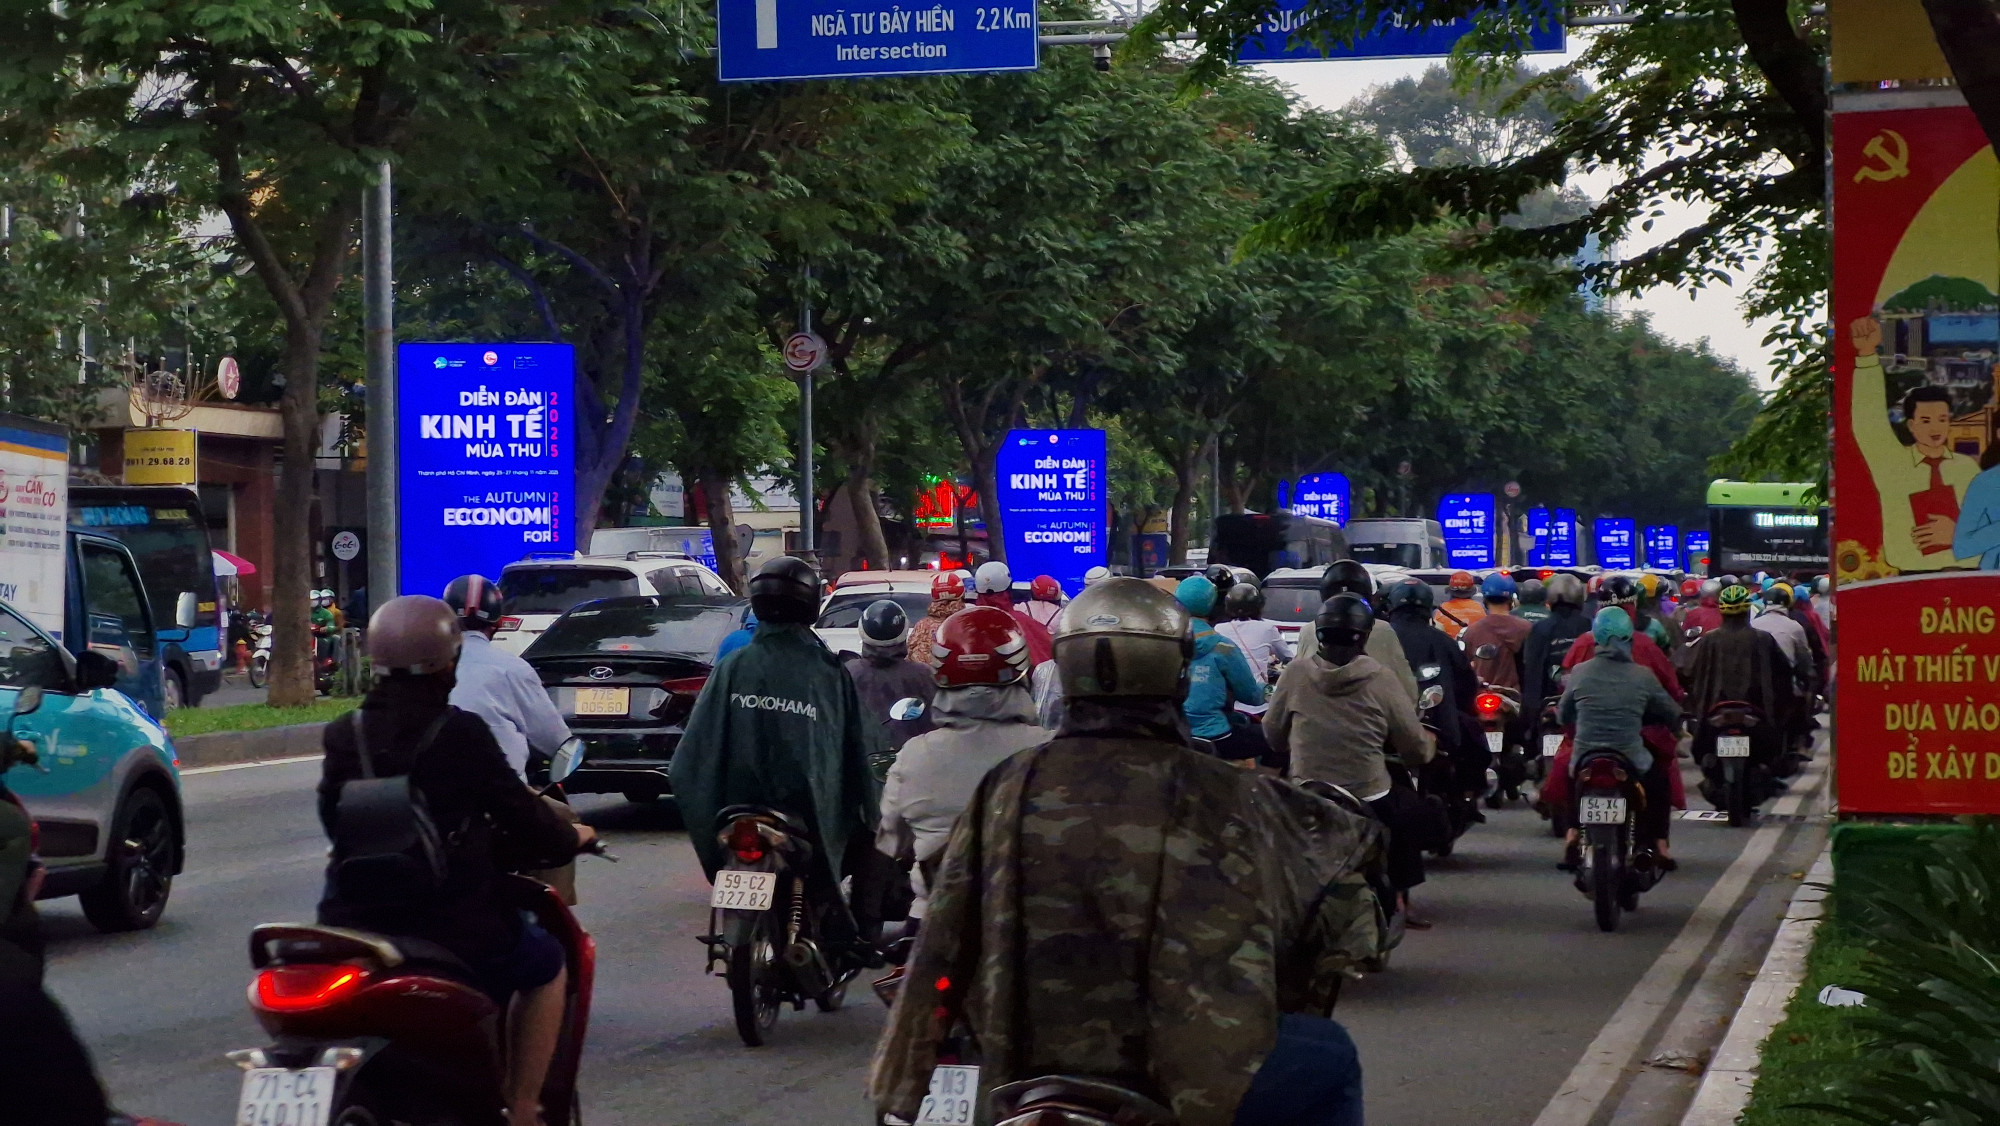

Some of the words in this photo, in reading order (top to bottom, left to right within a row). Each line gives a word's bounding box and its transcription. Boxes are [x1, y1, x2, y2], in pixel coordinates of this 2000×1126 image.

[811, 10, 847, 36] NGÃ
[851, 11, 875, 35] TƯ
[879, 5, 911, 34] BẢY
[915, 3, 954, 32] HIỀN
[976, 7, 1000, 33] 2,2
[1003, 6, 1031, 29] Km
[836, 42, 947, 61] Intersection
[459, 385, 499, 406] DIỄN
[504, 388, 542, 406] ĐÀN
[420, 415, 495, 439] KINH
[506, 406, 545, 439] TẾ
[550, 391, 559, 458] 2025
[466, 440, 504, 458] MÙA
[508, 443, 541, 458] THU
[1035, 456, 1060, 469] DIỄN
[1062, 457, 1086, 469] ĐÀN
[1010, 473, 1057, 490] KINH
[1063, 469, 1087, 489] TẾ
[463, 495, 481, 504] THE
[485, 492, 546, 504] AUTUMN
[1038, 489, 1062, 501] MÙA
[1064, 491, 1086, 501] THU
[443, 507, 550, 526] ECONOMI
[552, 492, 560, 542] 2025
[1322, 500, 1340, 515] TẾ
[1050, 521, 1088, 529] AUTUMN
[1803, 515, 1819, 527] BUS
[523, 531, 552, 543] FOR
[1024, 531, 1091, 543] ECONOMI
[1073, 546, 1091, 554] FOR
[1920, 597, 1996, 634] ĐẢNG
[1857, 647, 1906, 691] MẬT
[1913, 643, 1976, 683] THIẾT
[739, 694, 817, 721] YOKOHAMA
[1944, 696, 2000, 732] VÀO
[1887, 737, 1919, 779] ĐỂ
[1925, 744, 1976, 779] XÂY
[1587, 810, 1618, 822] 9512
[725, 874, 766, 891] 59-C2
[716, 890, 768, 908] 327.82
[256, 1072, 317, 1099] 71-C4
